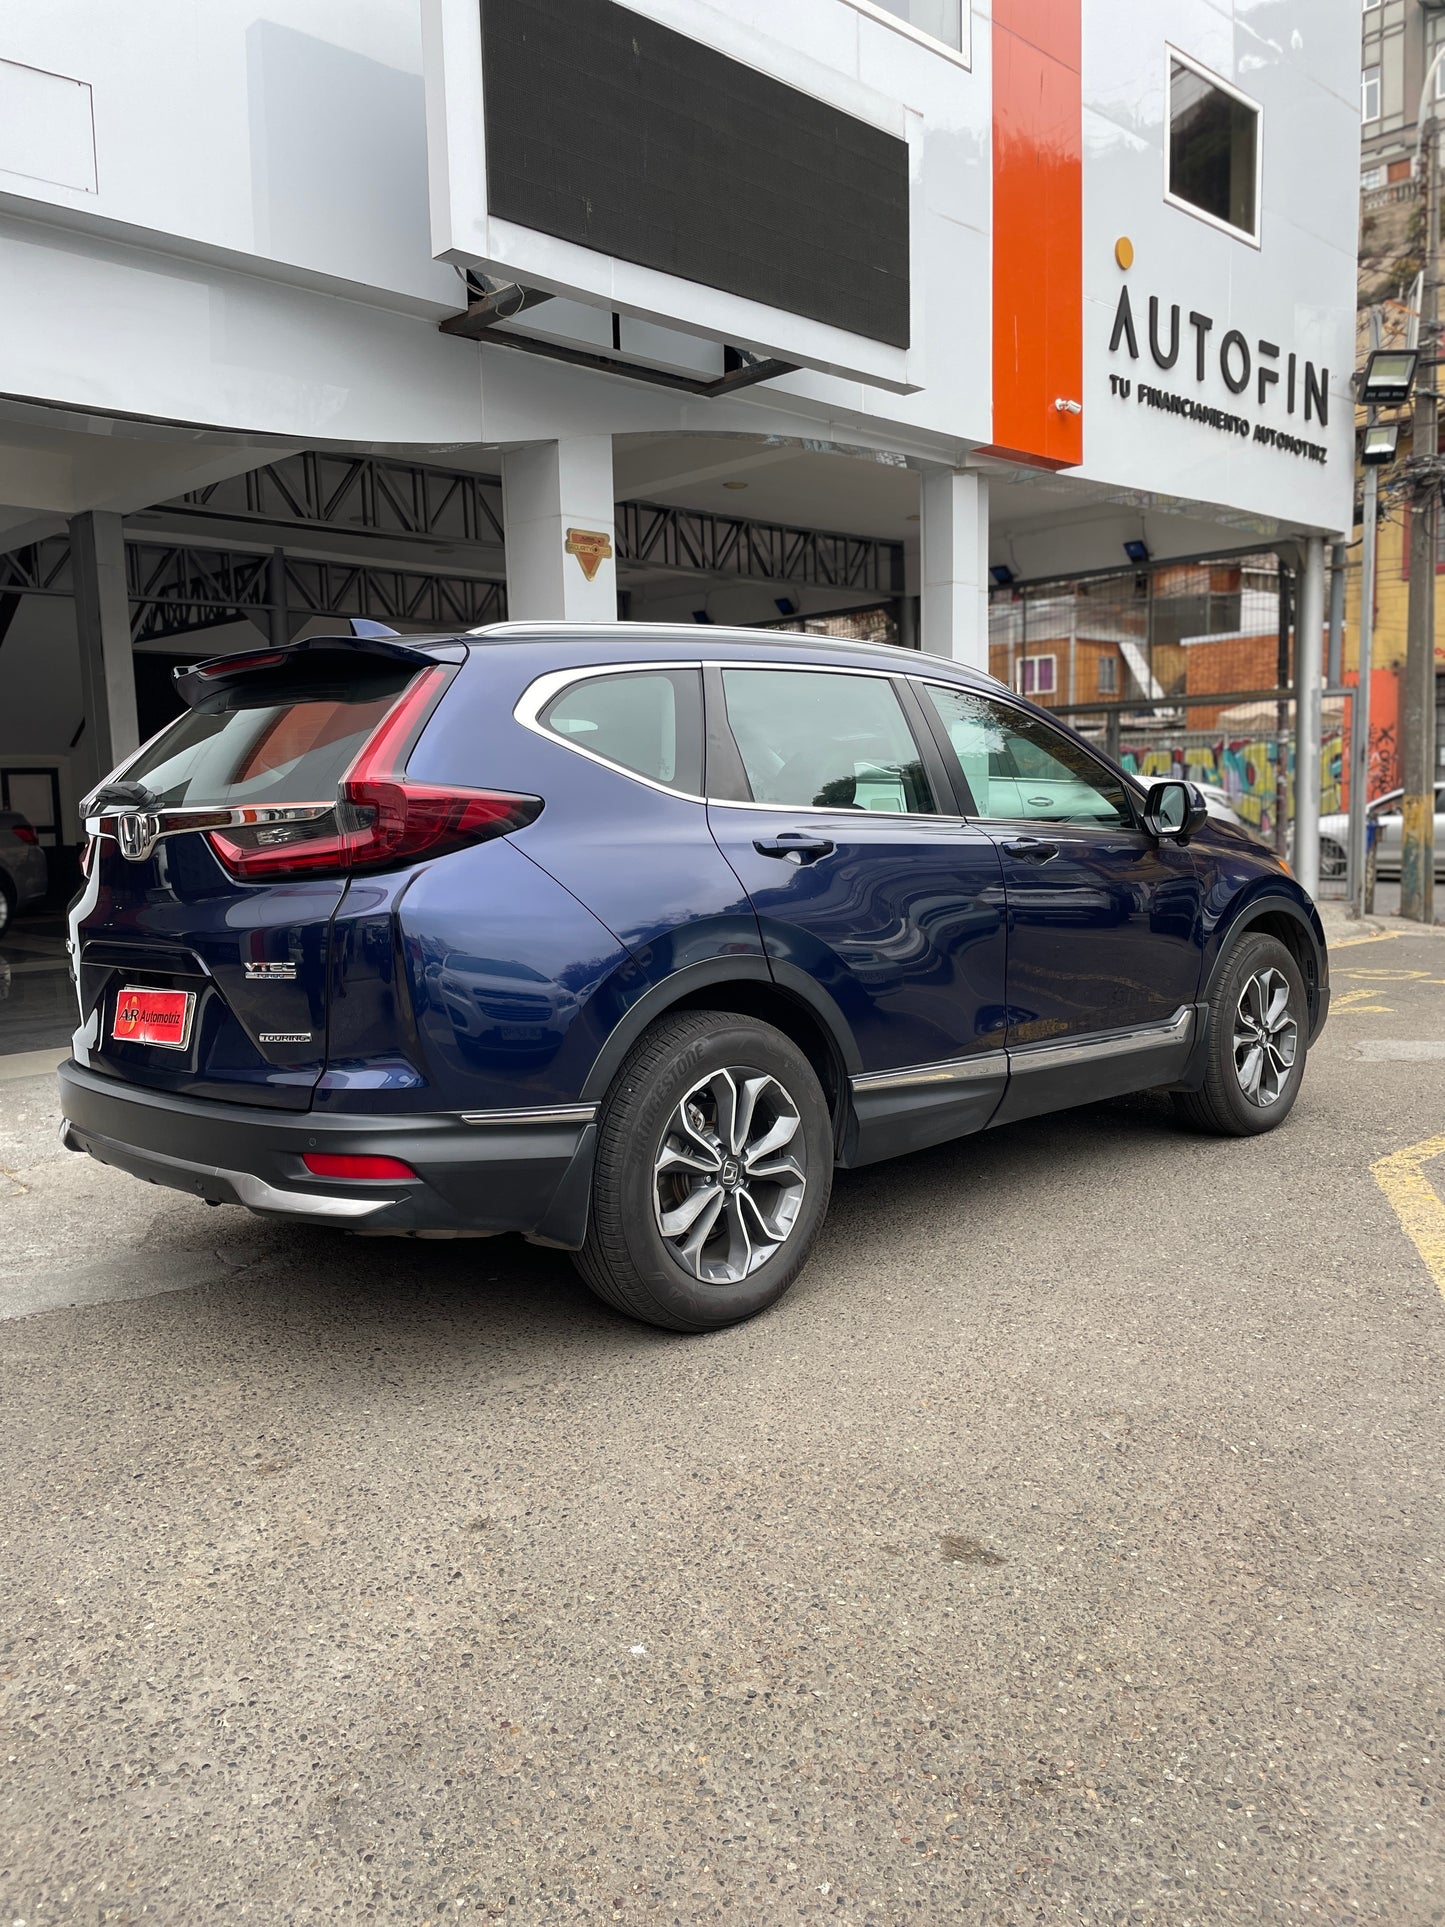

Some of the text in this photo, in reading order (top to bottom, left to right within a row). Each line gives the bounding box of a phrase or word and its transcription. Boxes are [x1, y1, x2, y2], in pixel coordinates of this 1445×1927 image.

[1109, 285, 1328, 427] AUTOFIN
[1109, 374, 1328, 465] TU FINANCIAMIENTO AUTOMOTRIZ
[244, 962, 296, 972] VTEC
[140, 1009, 181, 1024] Automotriz
